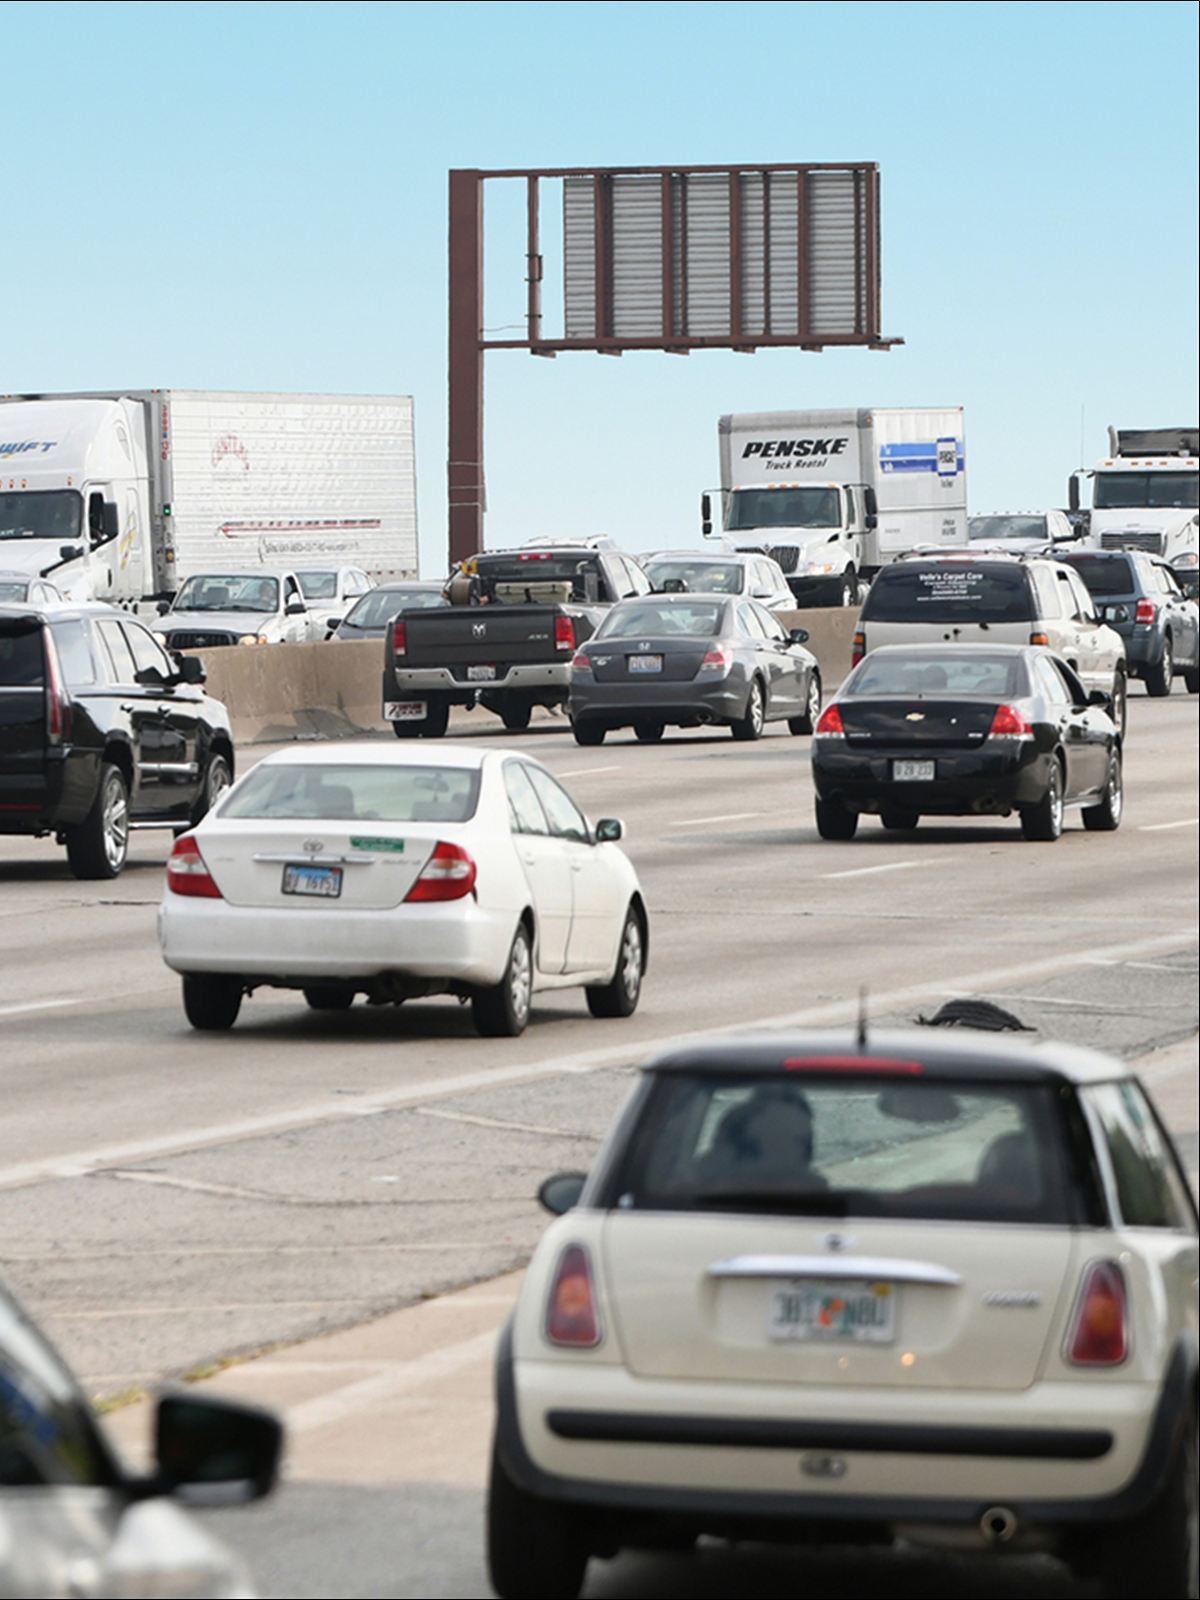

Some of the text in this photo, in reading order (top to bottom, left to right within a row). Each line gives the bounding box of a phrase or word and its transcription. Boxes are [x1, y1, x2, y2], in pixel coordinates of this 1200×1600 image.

[741, 438, 849, 459] PENSKE
[765, 459, 827, 470] Truck Rental
